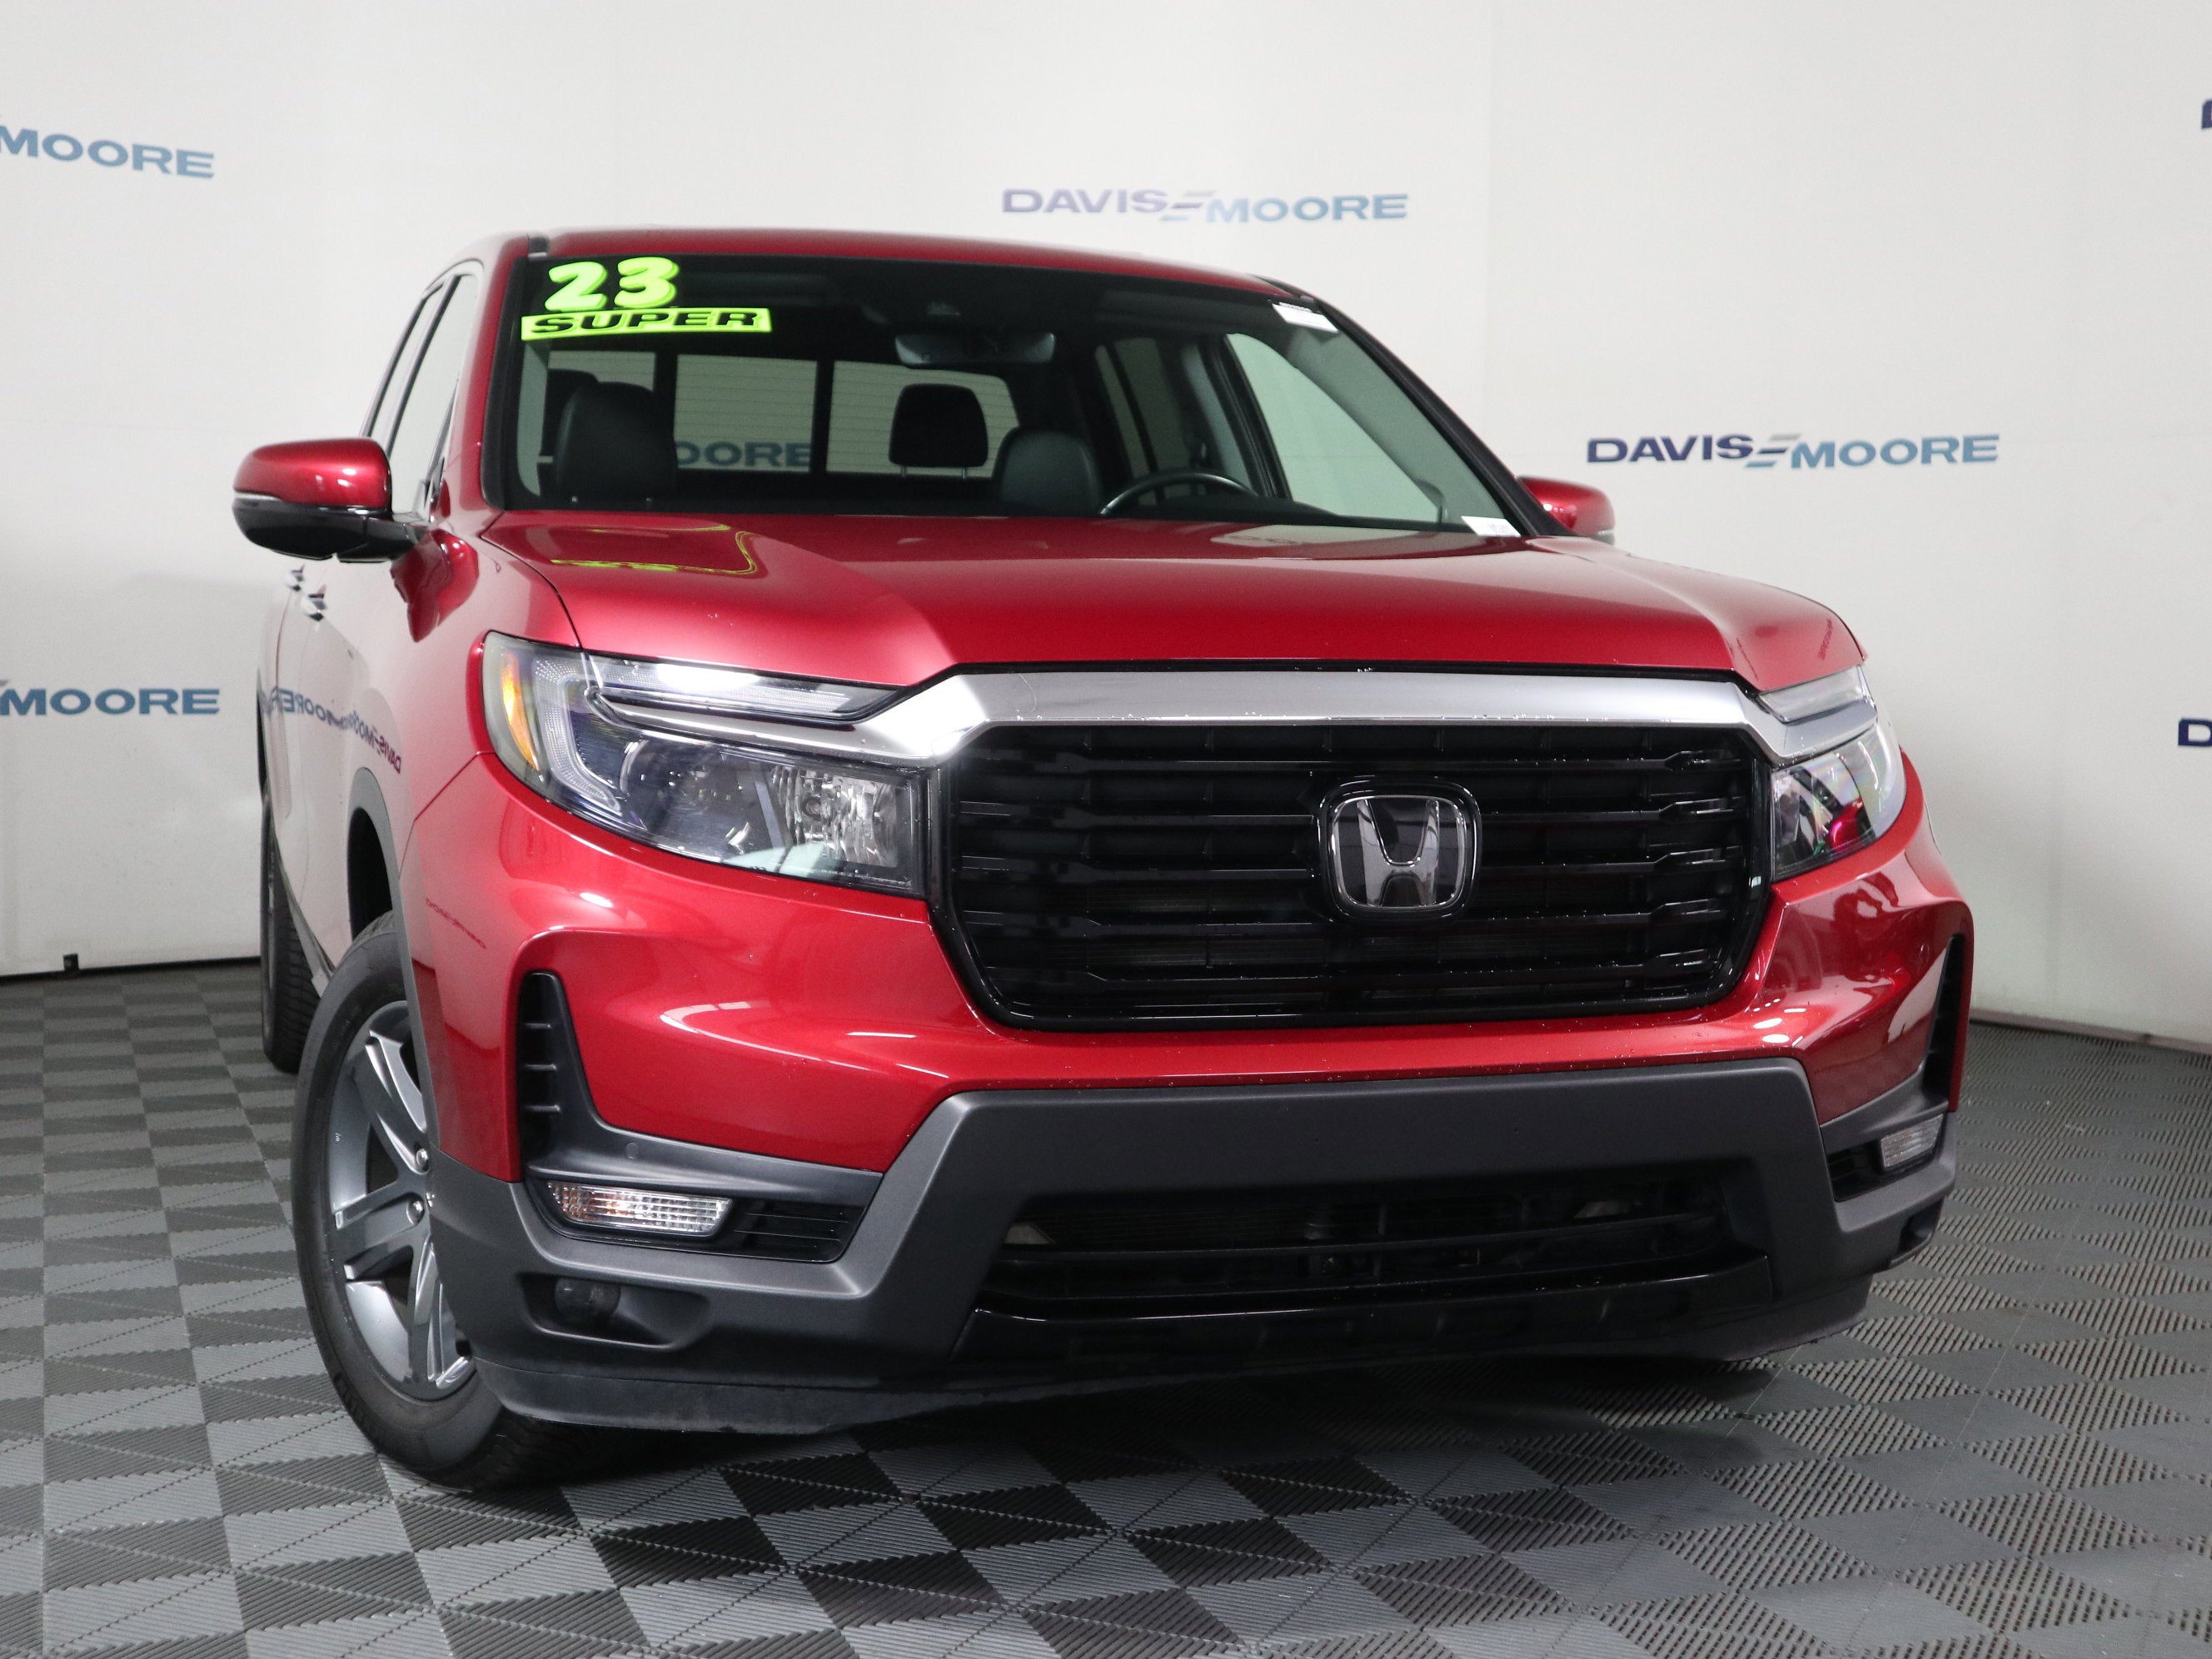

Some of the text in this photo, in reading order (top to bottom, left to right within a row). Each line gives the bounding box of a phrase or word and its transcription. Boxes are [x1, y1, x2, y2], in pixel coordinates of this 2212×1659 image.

[0, 125, 214, 178] MOORE
[1001, 188, 1408, 222] DAVIS MOORE
[545, 257, 680, 311] 23
[531, 311, 760, 334] SUPER
[1587, 434, 2000, 469] DAVIS MOORE
[0, 687, 220, 715] MOORE
